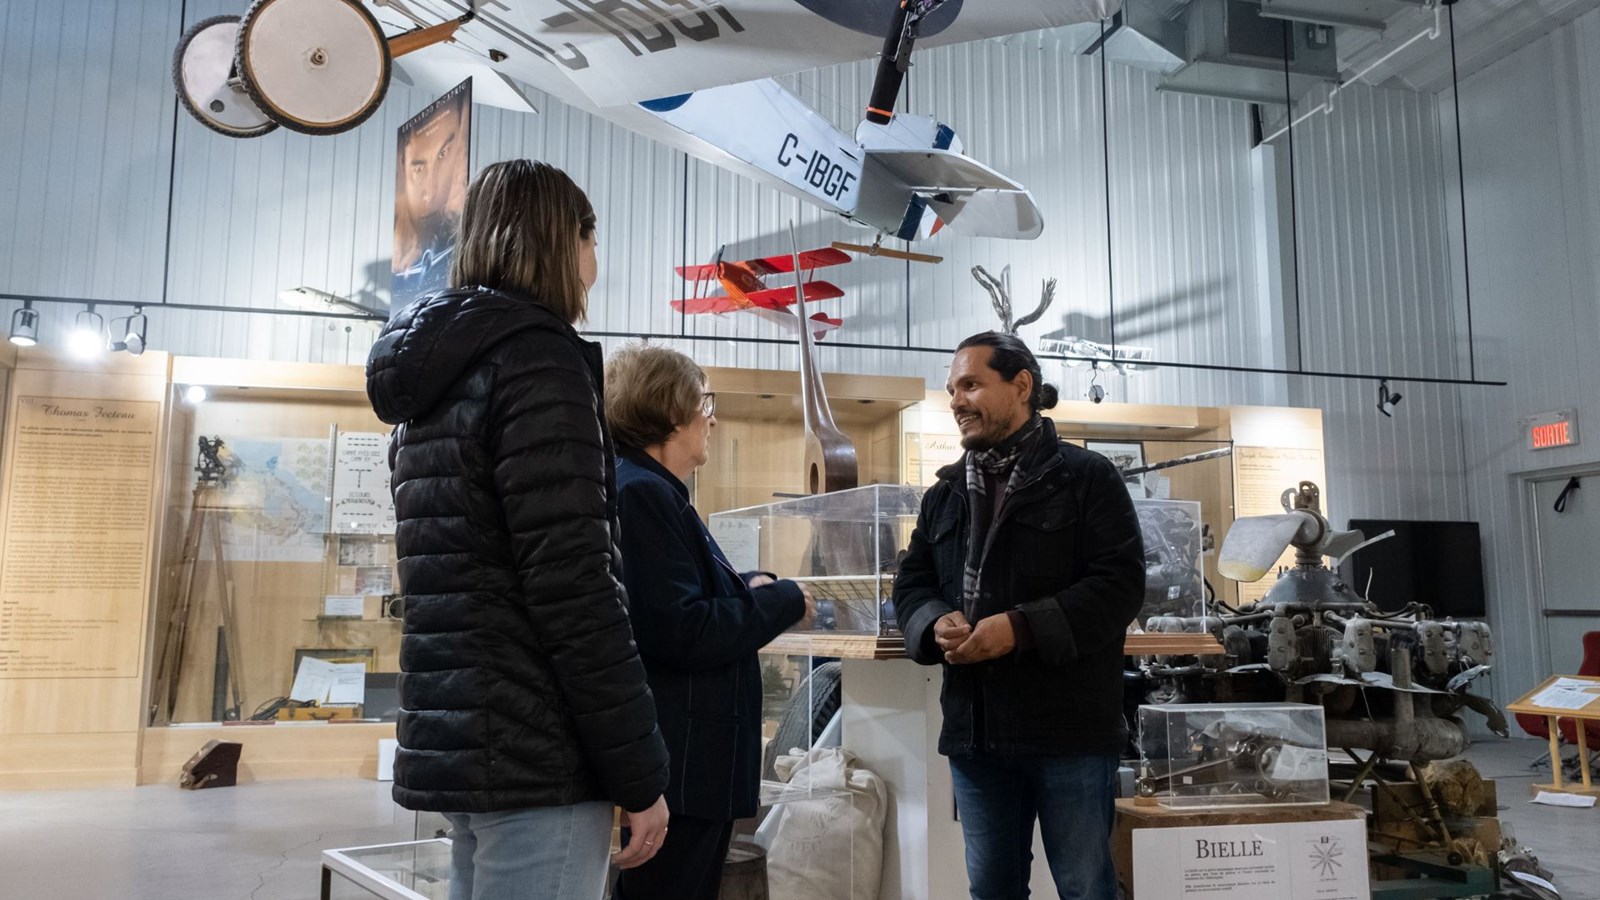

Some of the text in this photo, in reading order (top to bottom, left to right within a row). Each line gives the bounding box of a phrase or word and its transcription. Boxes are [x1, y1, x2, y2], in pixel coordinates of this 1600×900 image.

[777, 132, 857, 201] C-IBGF
[41, 404, 89, 418] Thomas
[1531, 421, 1569, 449] SORTIE
[1195, 839, 1264, 859] BIELLE
